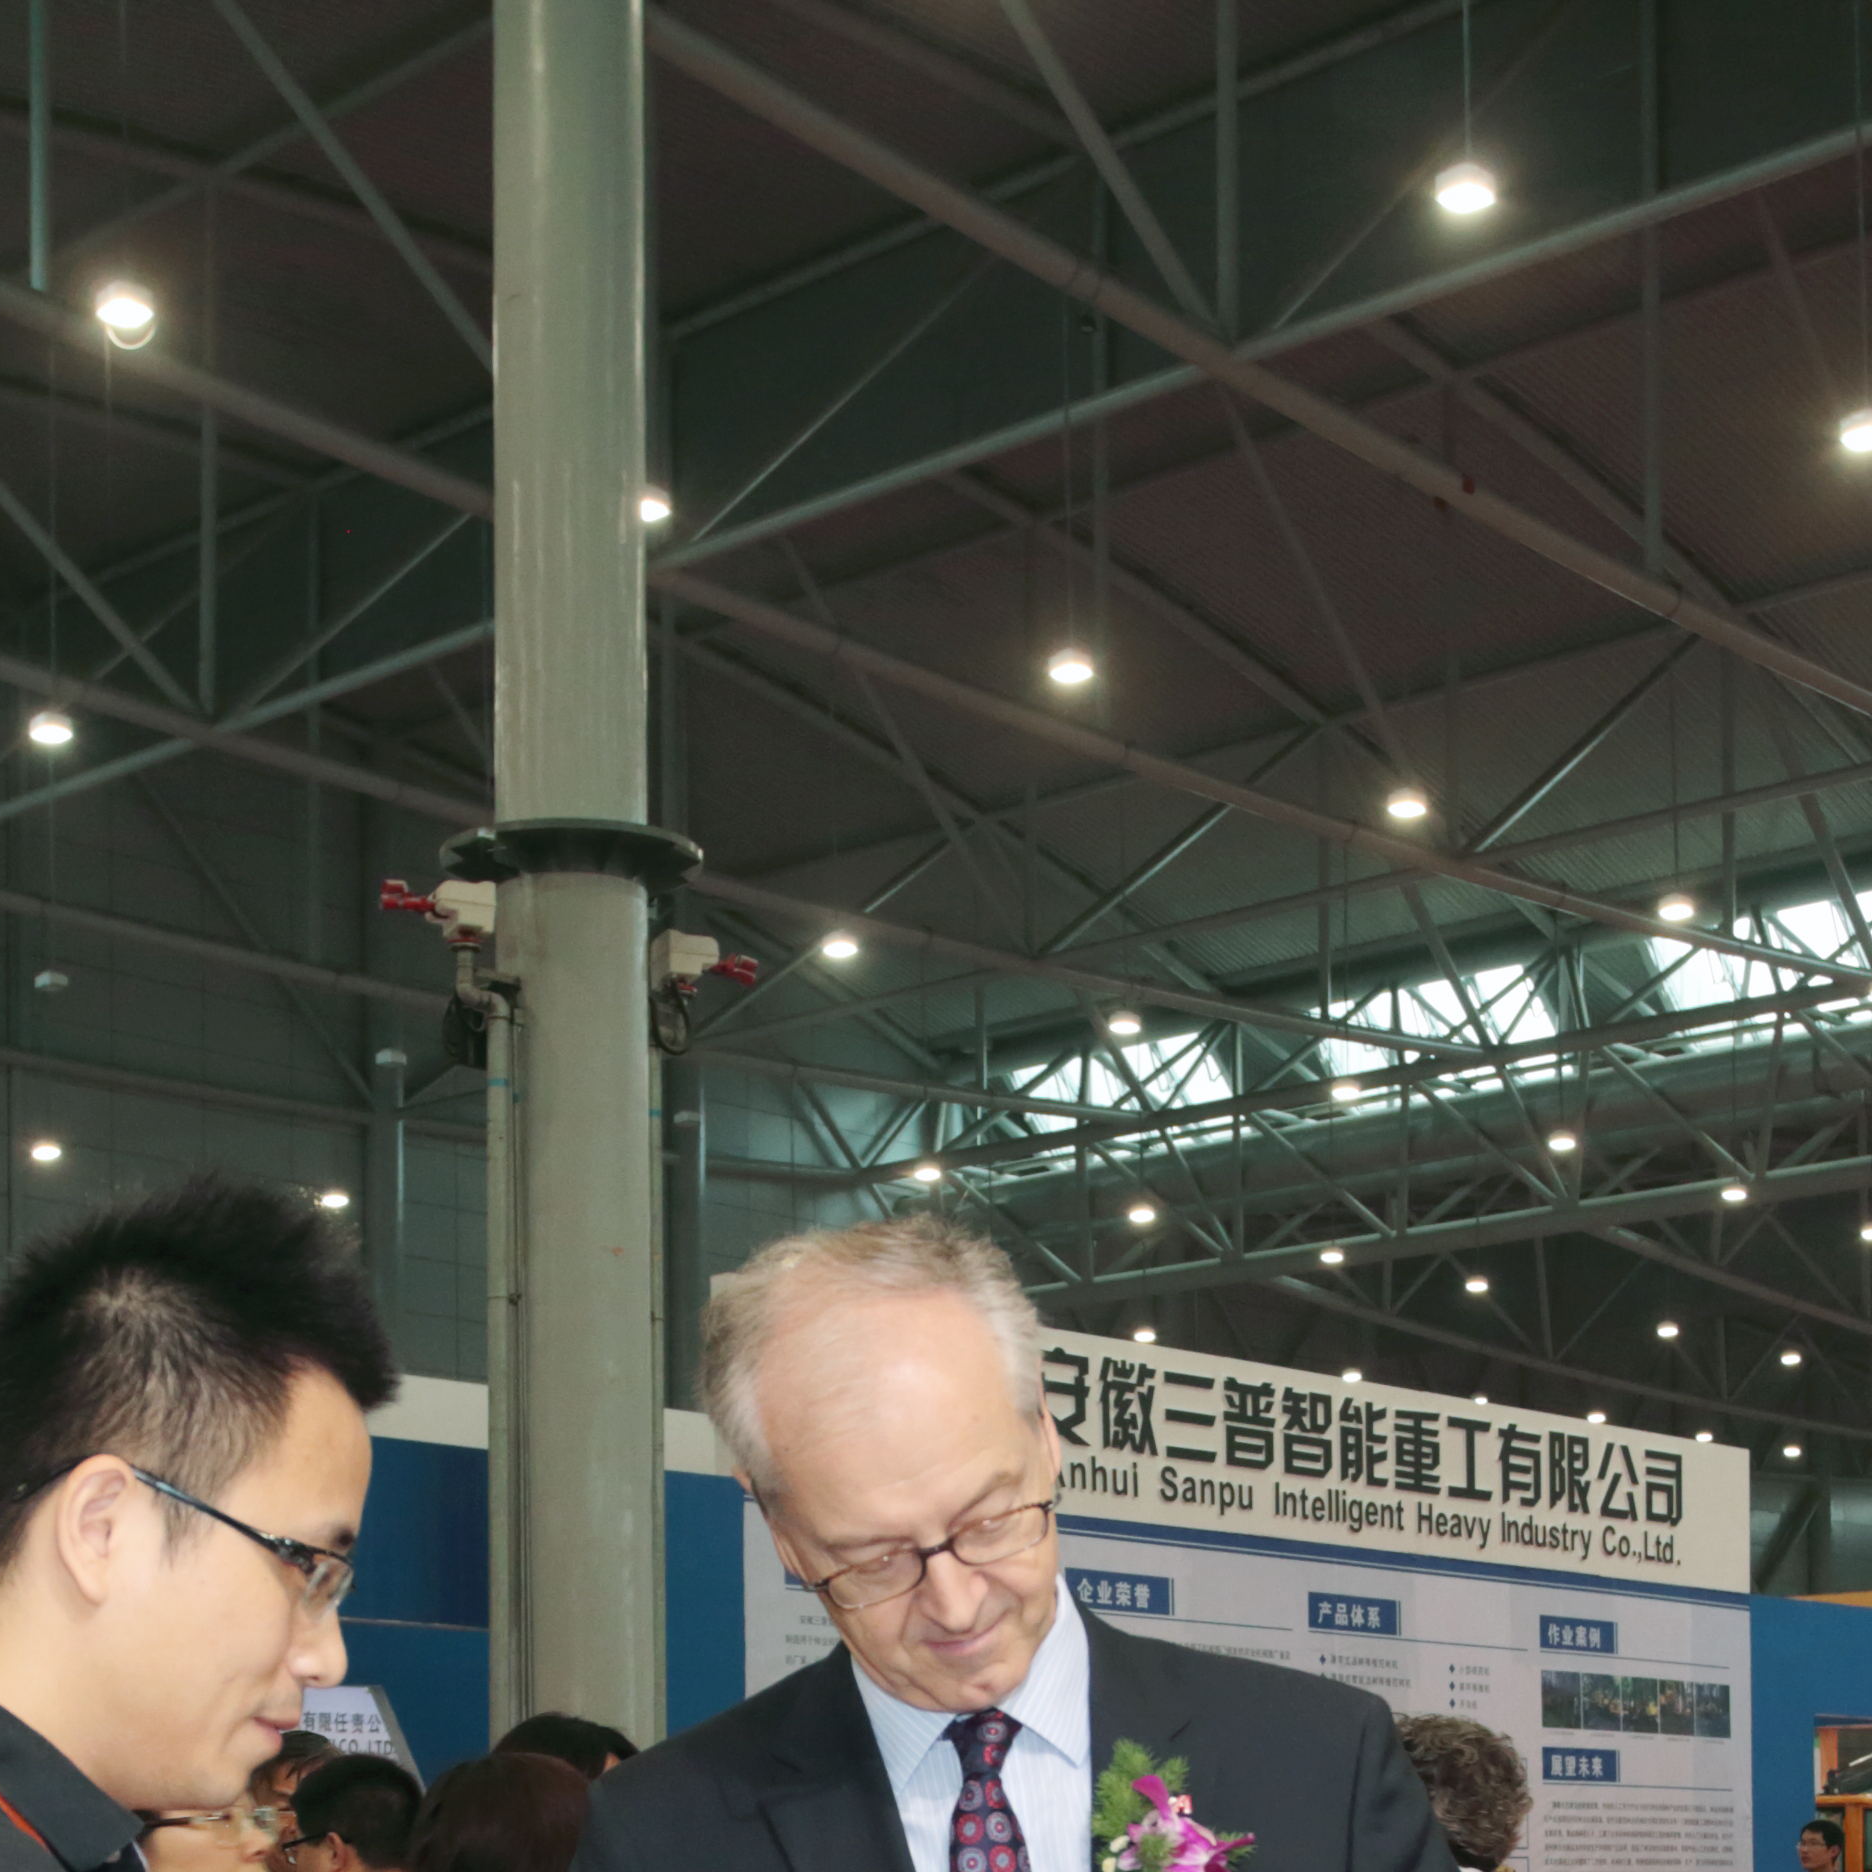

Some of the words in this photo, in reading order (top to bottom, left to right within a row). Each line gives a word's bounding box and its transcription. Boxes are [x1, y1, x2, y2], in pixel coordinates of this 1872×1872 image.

[1042, 1347, 1683, 1527] 安徽三普智能重工有限公司
[1160, 1466, 1254, 1516] Sanpu
[1275, 1482, 1405, 1532] Intelligent
[1418, 1501, 1492, 1550] Heavy
[1501, 1511, 1592, 1561] Industry
[1603, 1525, 1681, 1566] Co.,Ltd.
[1078, 1578, 1151, 1609] 企业荣誉
[1318, 1601, 1381, 1629] 产品体系
[1548, 1623, 1601, 1649] 作业案例
[1551, 1755, 1603, 1777] 展望未来
